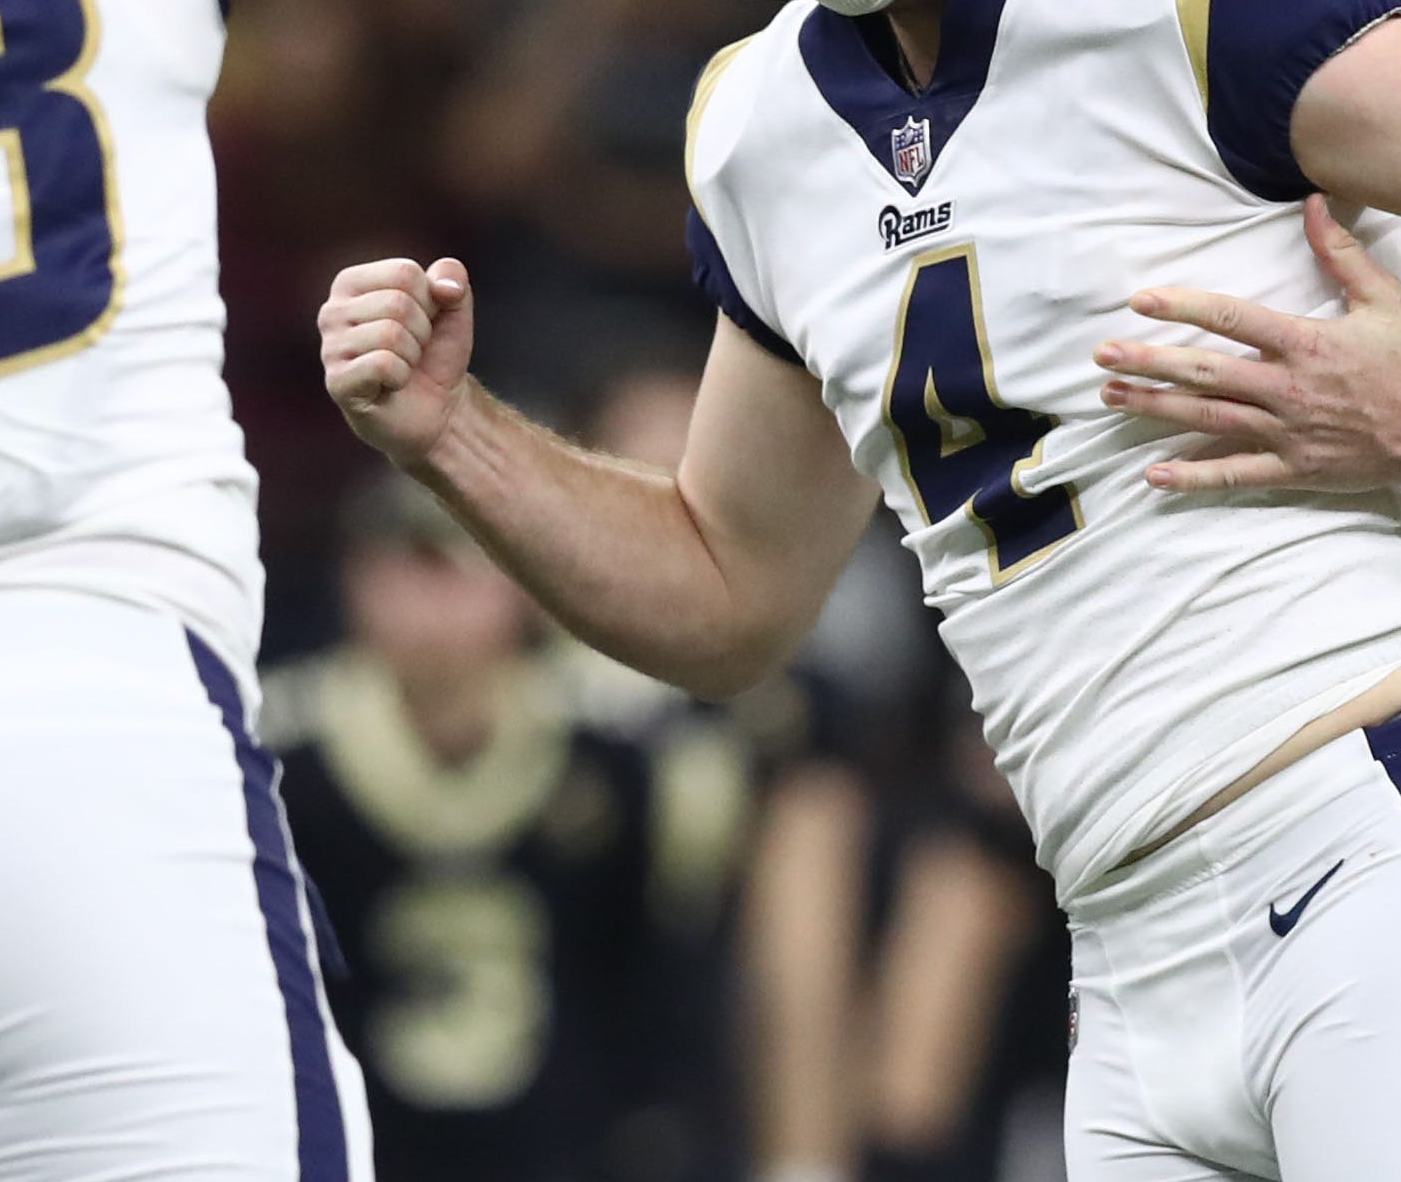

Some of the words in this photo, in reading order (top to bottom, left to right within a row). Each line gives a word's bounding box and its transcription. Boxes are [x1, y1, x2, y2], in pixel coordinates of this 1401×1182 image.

[899, 146, 924, 173] NFL
[879, 204, 951, 250] Rams
[883, 243, 1085, 586] 4
